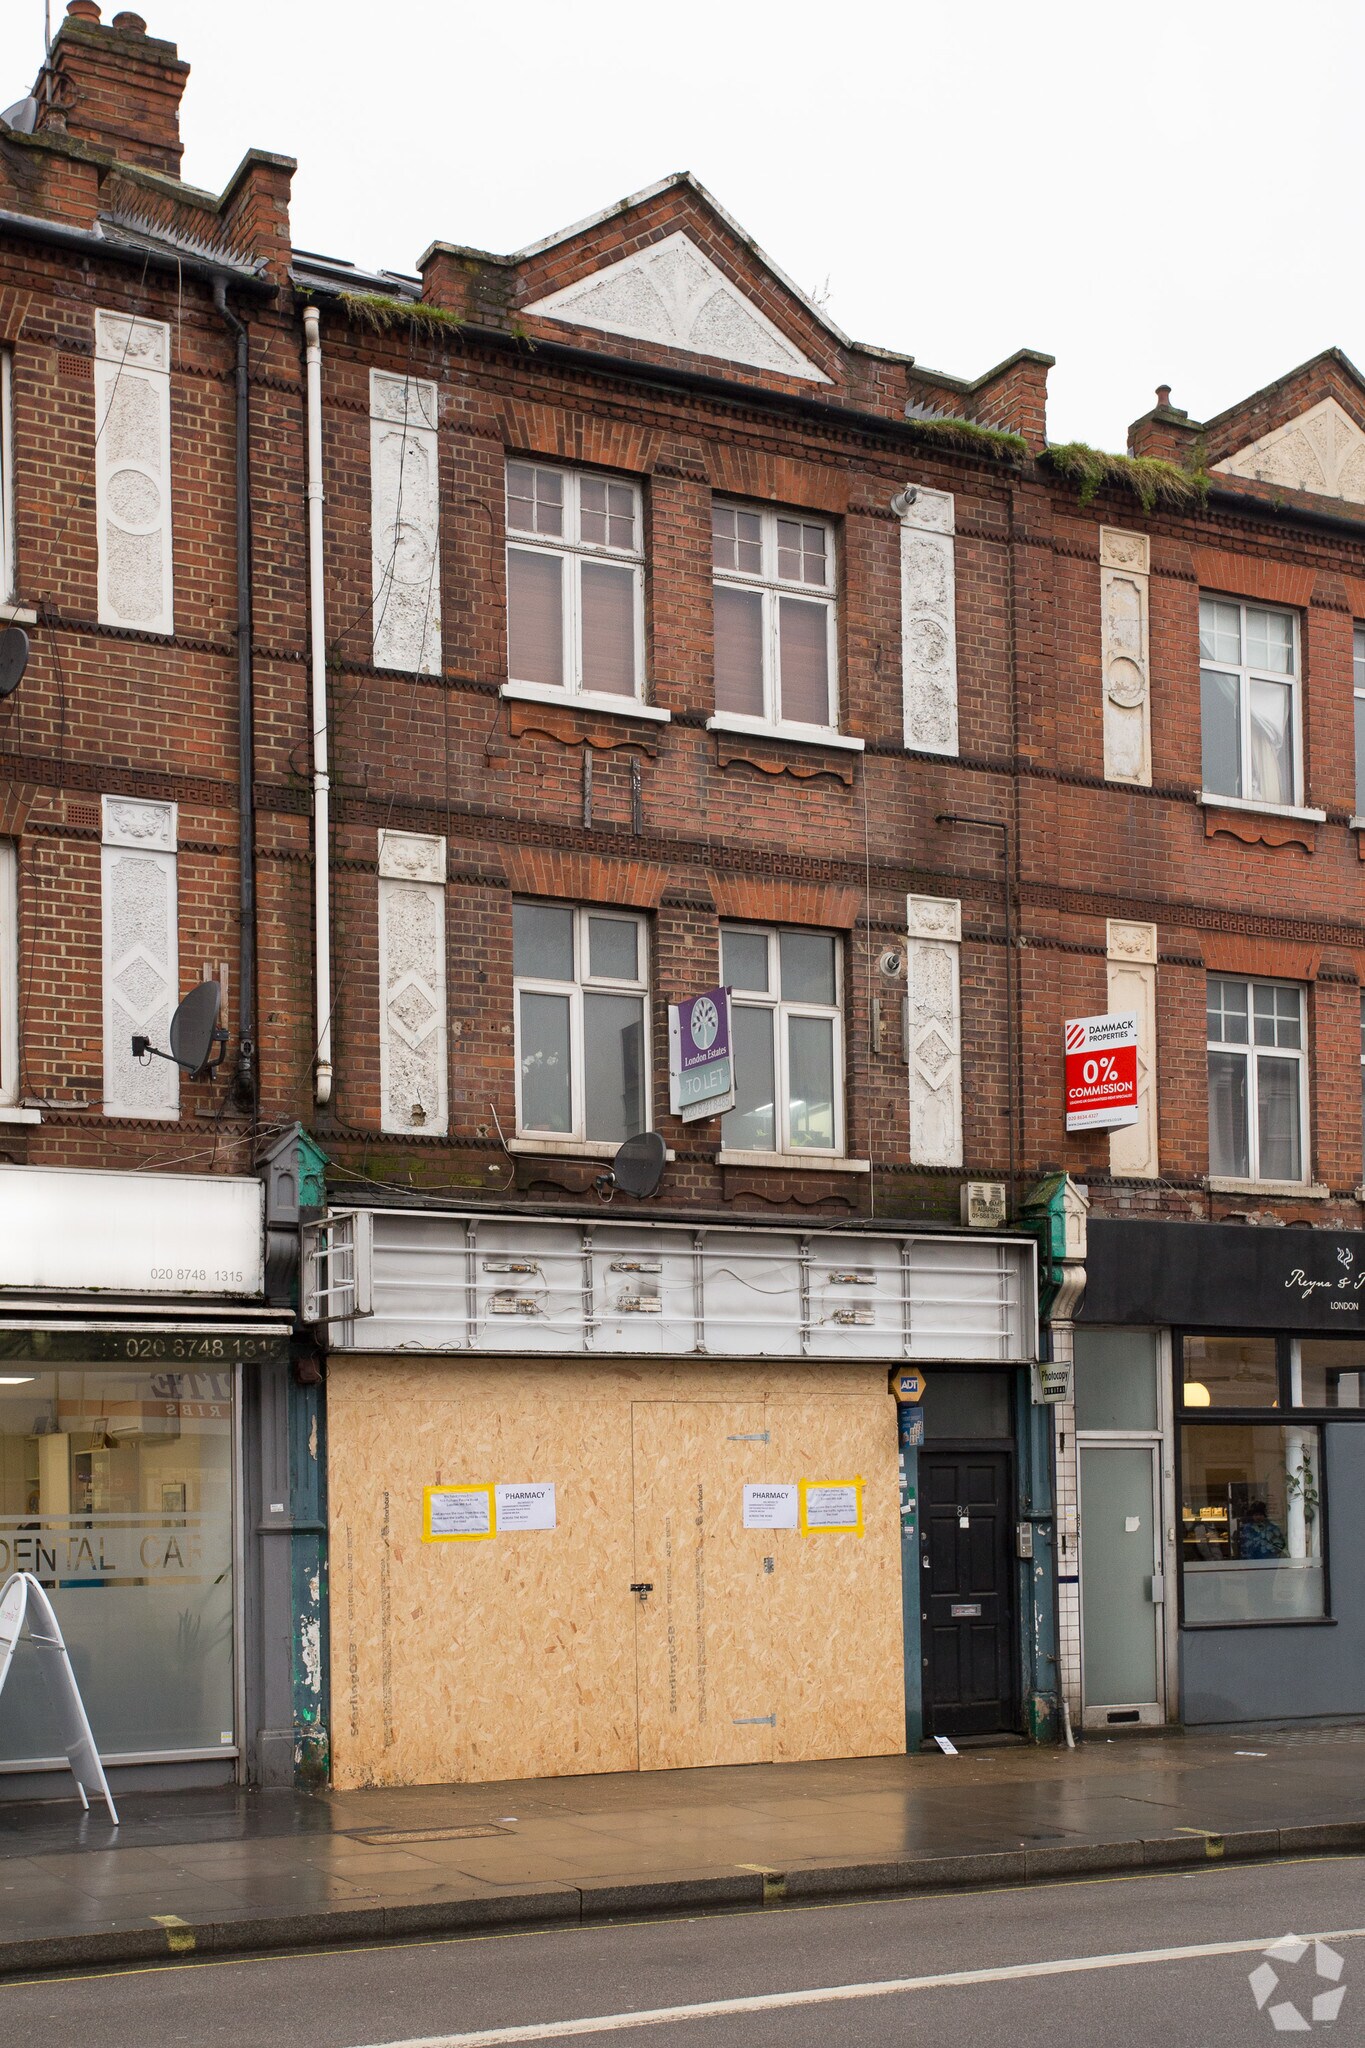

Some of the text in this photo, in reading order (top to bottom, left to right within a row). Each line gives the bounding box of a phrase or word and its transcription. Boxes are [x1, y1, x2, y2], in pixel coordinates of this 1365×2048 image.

[1089, 1020, 1134, 1034] DAMMACK
[1089, 1031, 1128, 1042] PROPERTIES
[684, 1046, 727, 1067] London Estates
[1083, 1056, 1118, 1084] 0%
[686, 1068, 724, 1095] TO LET
[1069, 1081, 1133, 1098] COMMISSION
[150, 1268, 243, 1282] 020 8748 1315
[1337, 1277, 1351, 1289] &
[1330, 1301, 1359, 1310] LONDON
[126, 1338, 282, 1358] 020 8748 1315
[1041, 1370, 1068, 1382] Photocopy
[901, 1379, 918, 1390] ADT
[505, 1491, 546, 1500] PHARMACY
[956, 1505, 970, 1517] 84
